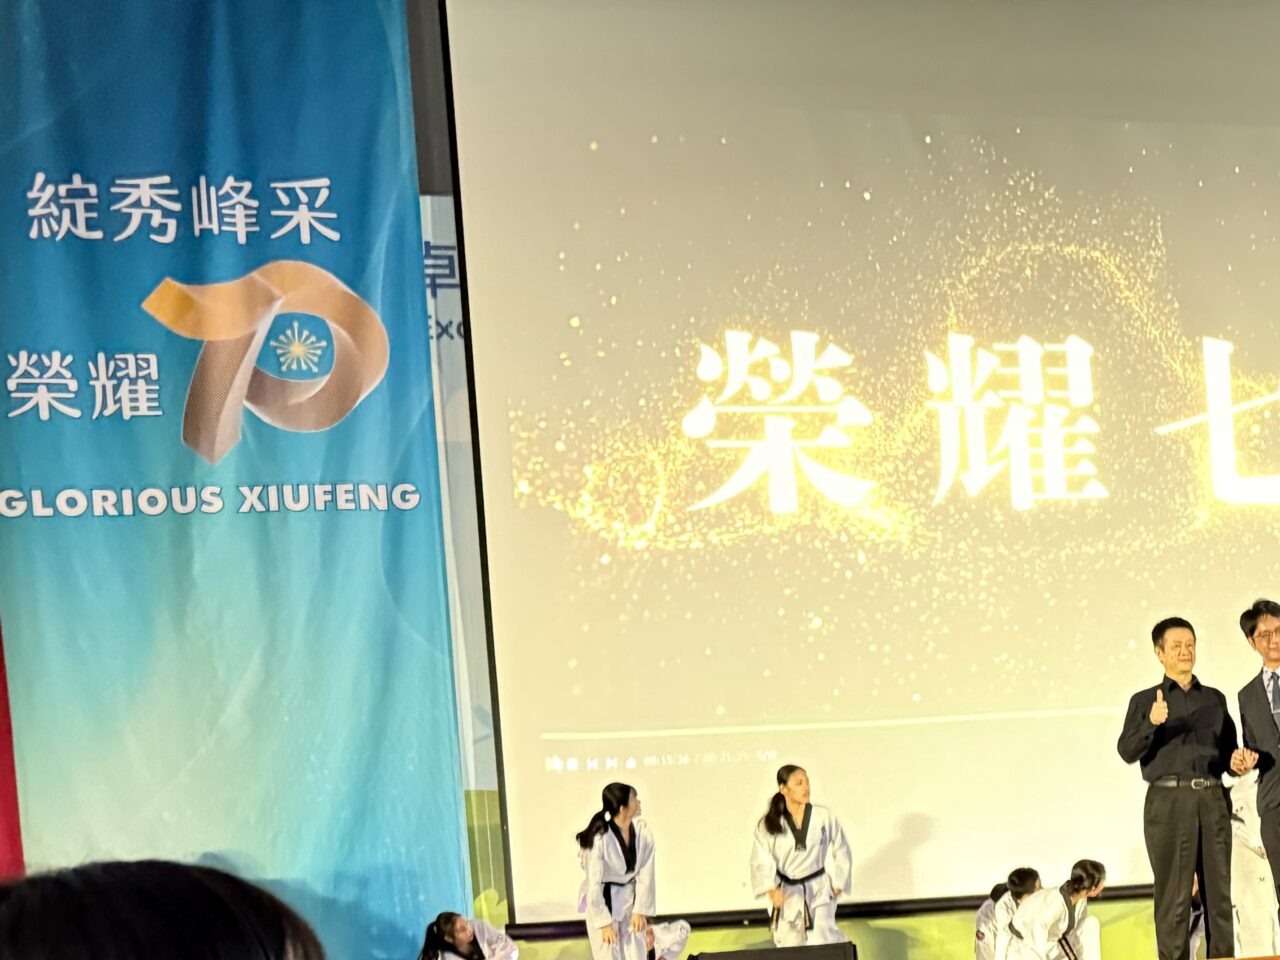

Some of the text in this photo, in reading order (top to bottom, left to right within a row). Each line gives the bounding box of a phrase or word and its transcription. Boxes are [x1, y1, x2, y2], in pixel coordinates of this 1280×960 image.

[26, 172, 341, 245] 綻秀峰采
[7, 350, 163, 421] 榮耀
[0, 484, 422, 519] GLORIOUS XIUFENG
